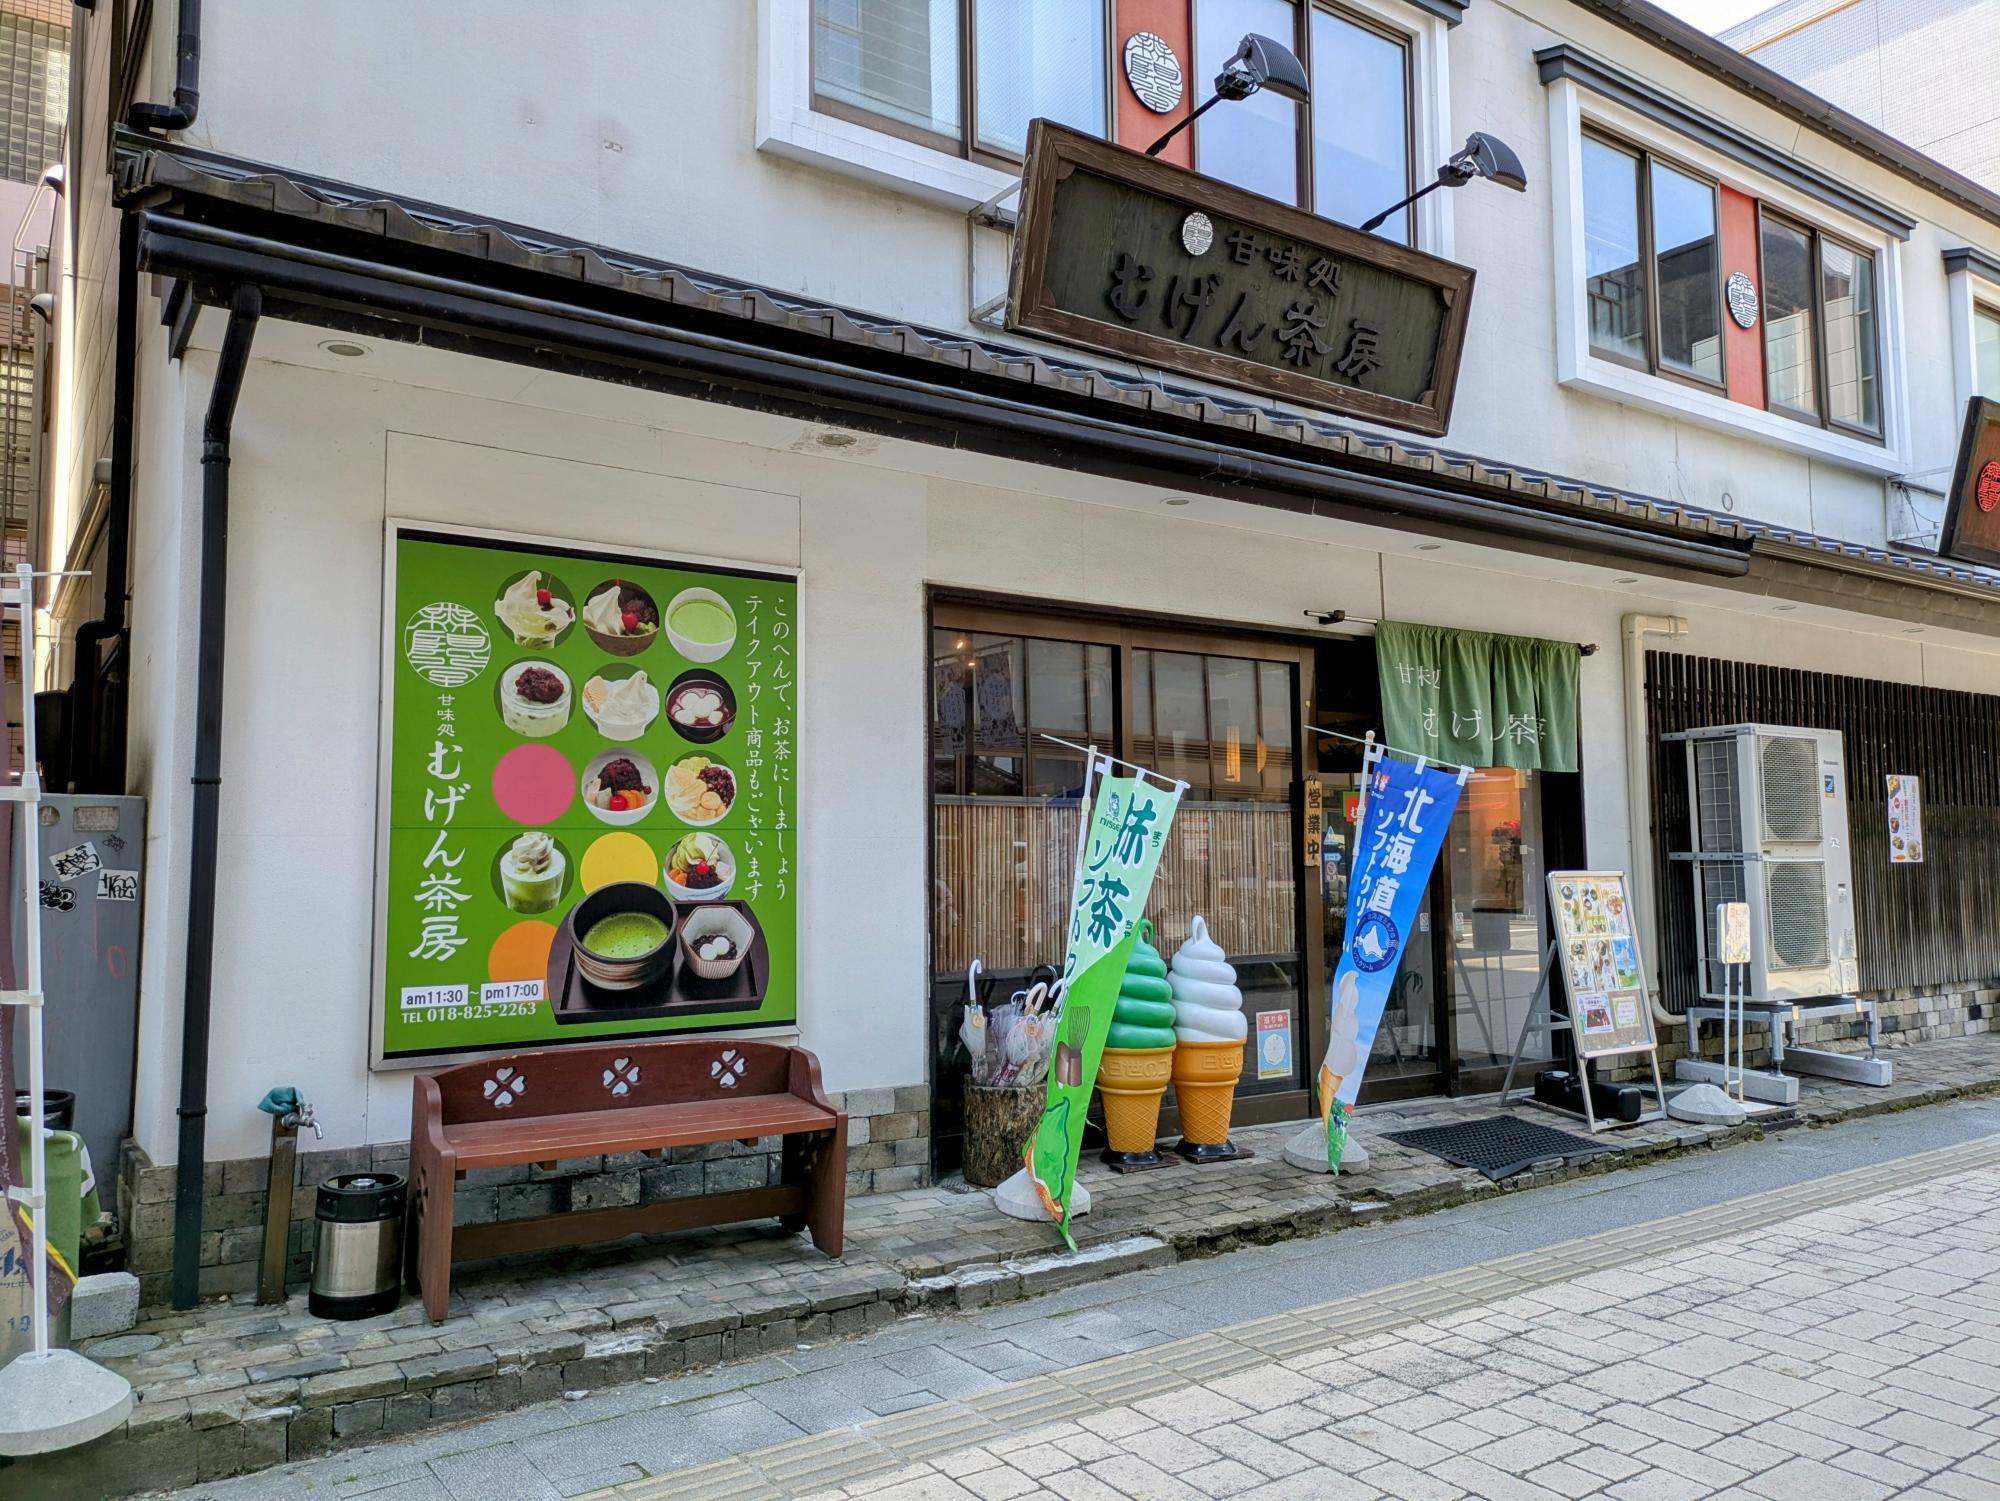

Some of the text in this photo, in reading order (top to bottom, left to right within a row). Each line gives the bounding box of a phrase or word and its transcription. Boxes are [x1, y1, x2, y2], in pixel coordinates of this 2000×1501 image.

[1228, 230, 1345, 297] 甘味処
[1108, 252, 1385, 384] むげん茶房
[437, 693, 455, 737] 甘味処
[745, 595, 763, 901] テイクアウト商品もございます
[773, 597, 792, 900] このへんで、お茶にしましょう
[408, 740, 473, 961] むげん茶房
[1307, 788, 1322, 860] 営業中
[1367, 786, 1435, 917] 北海道
[401, 1002, 536, 1024] TEL 018-825-2263
[406, 989, 463, 1005] am11:30
[485, 983, 539, 1000] pm17:00
[1107, 1058, 1170, 1078] 日世のコ
